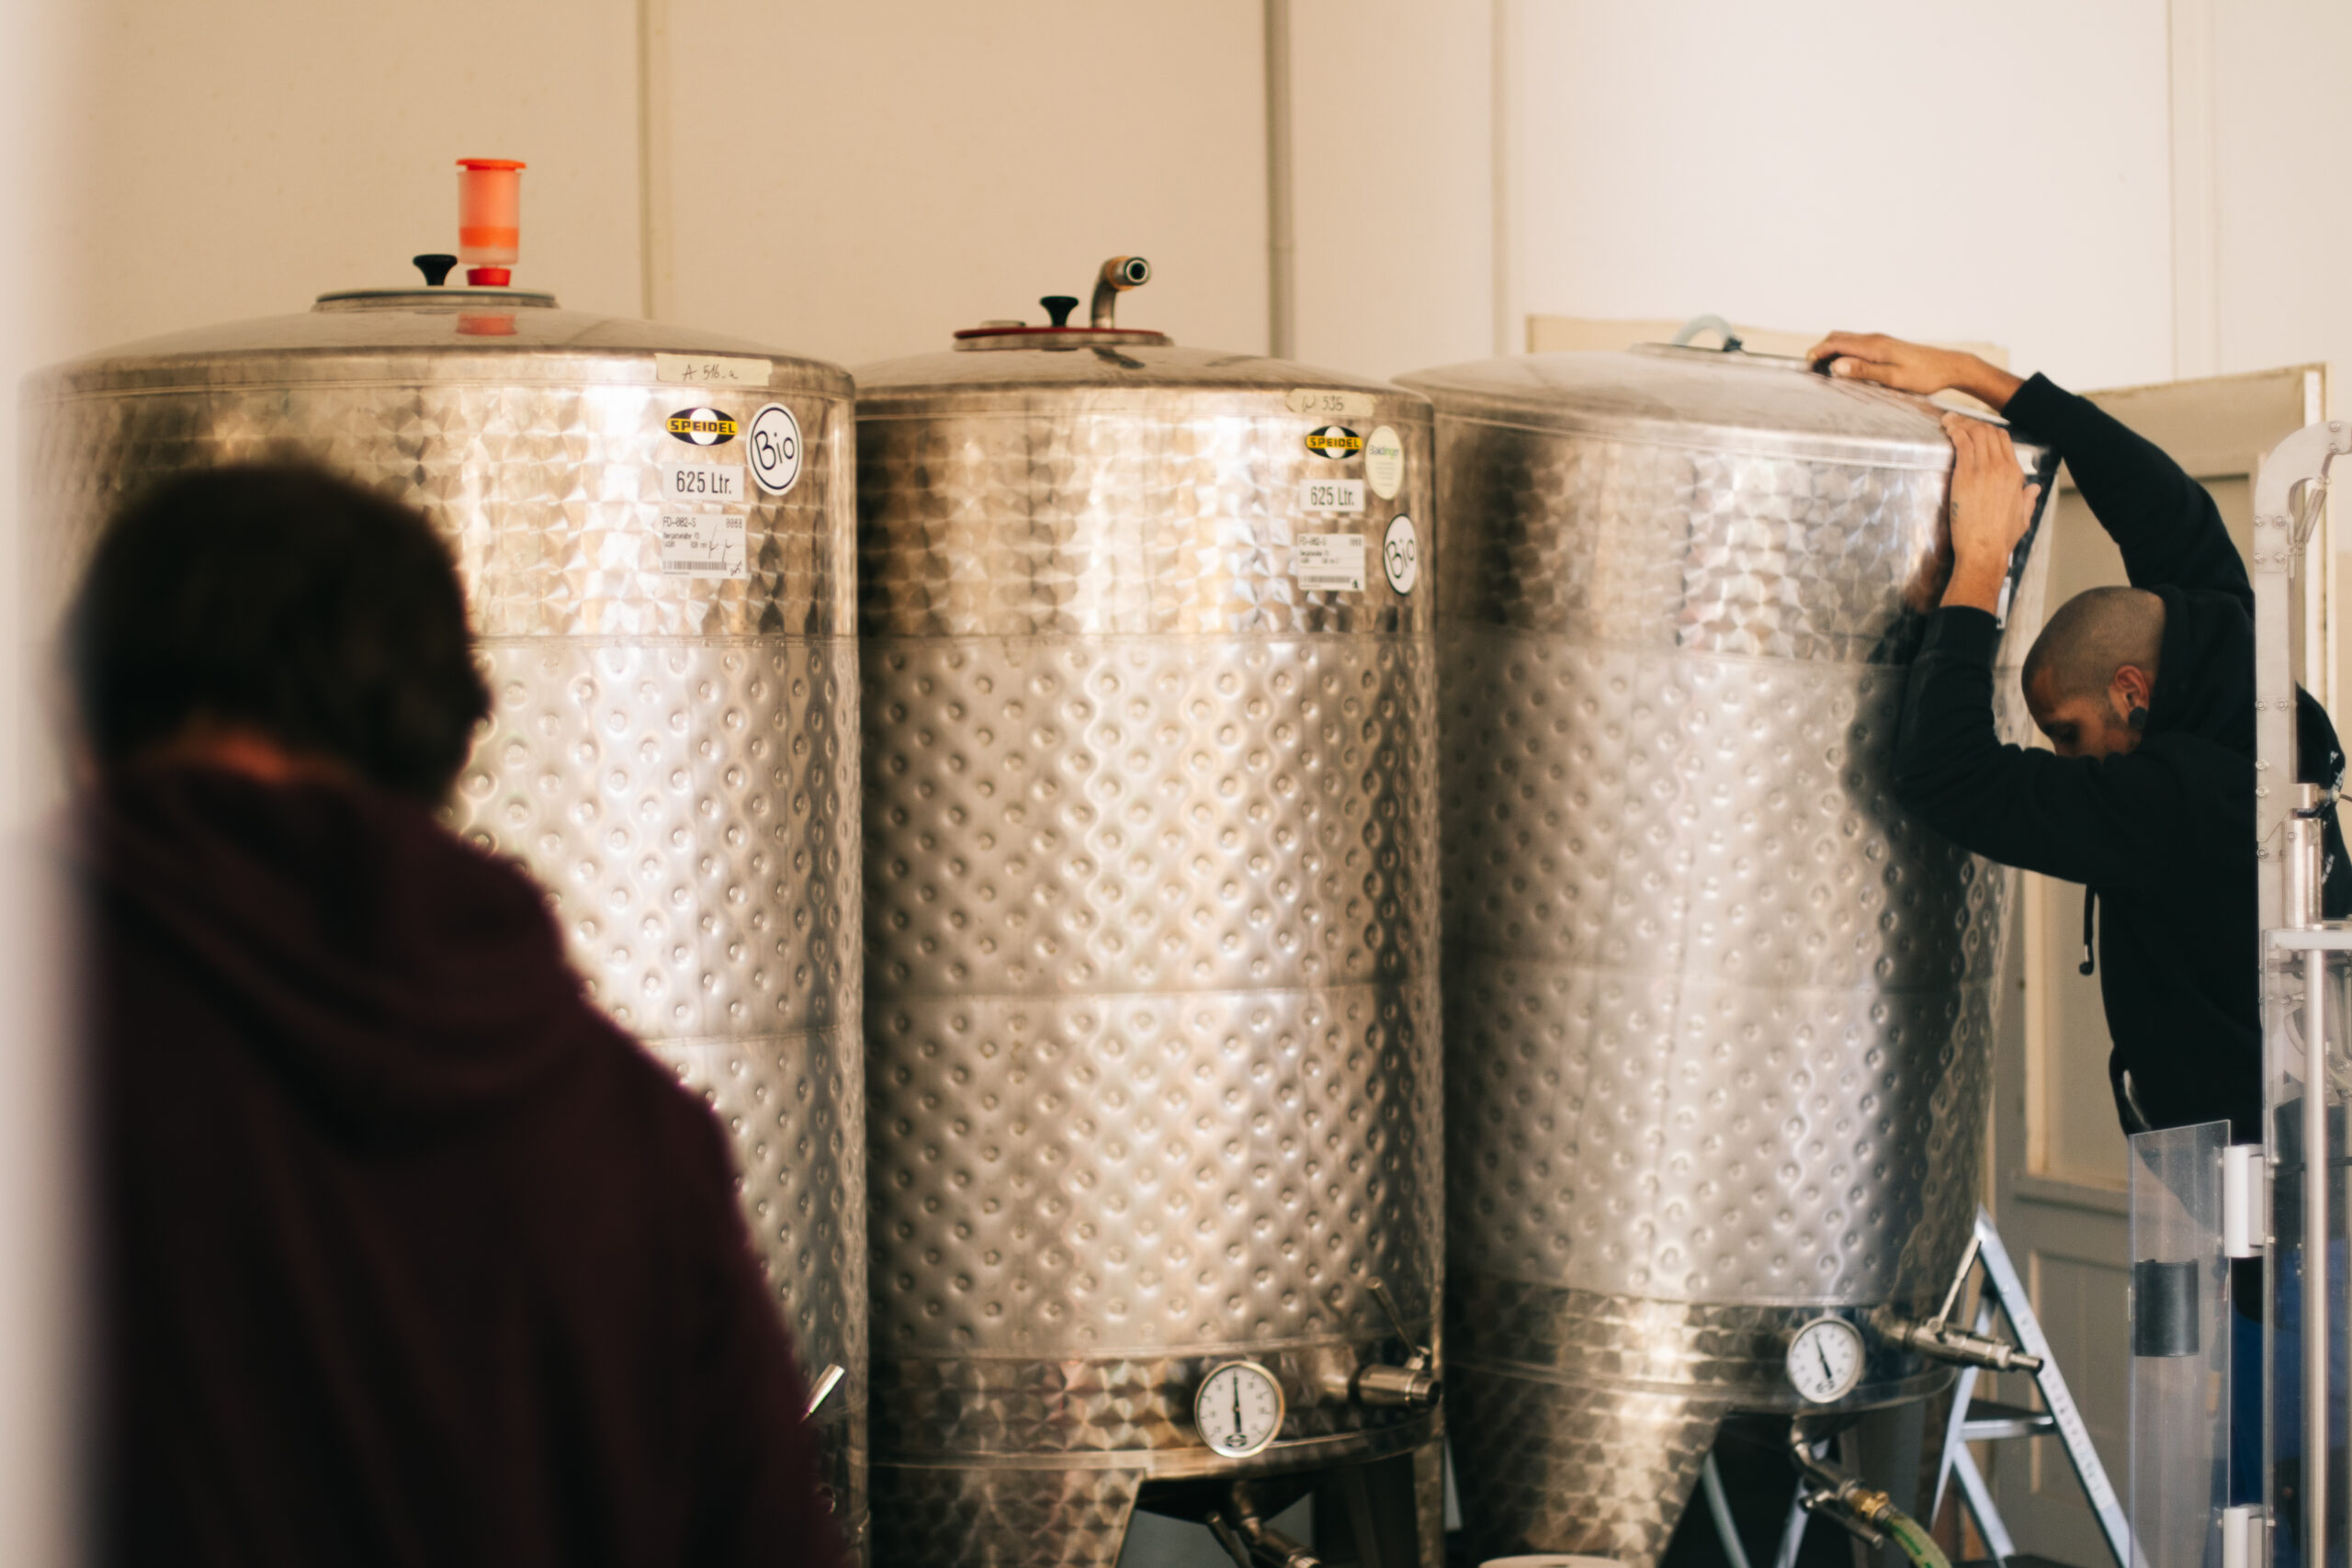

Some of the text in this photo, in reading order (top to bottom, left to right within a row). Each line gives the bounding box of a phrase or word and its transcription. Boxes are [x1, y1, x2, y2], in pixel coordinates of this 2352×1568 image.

[682, 364, 698, 380] A
[671, 420, 735, 434] SPEIDEL
[754, 430, 795, 470] Bio
[1309, 436, 1360, 448] SPEIDEL
[676, 471, 732, 494] 625 Ltr.
[1310, 487, 1355, 506] 625 Ltr.
[1385, 539, 1415, 579] Bio
